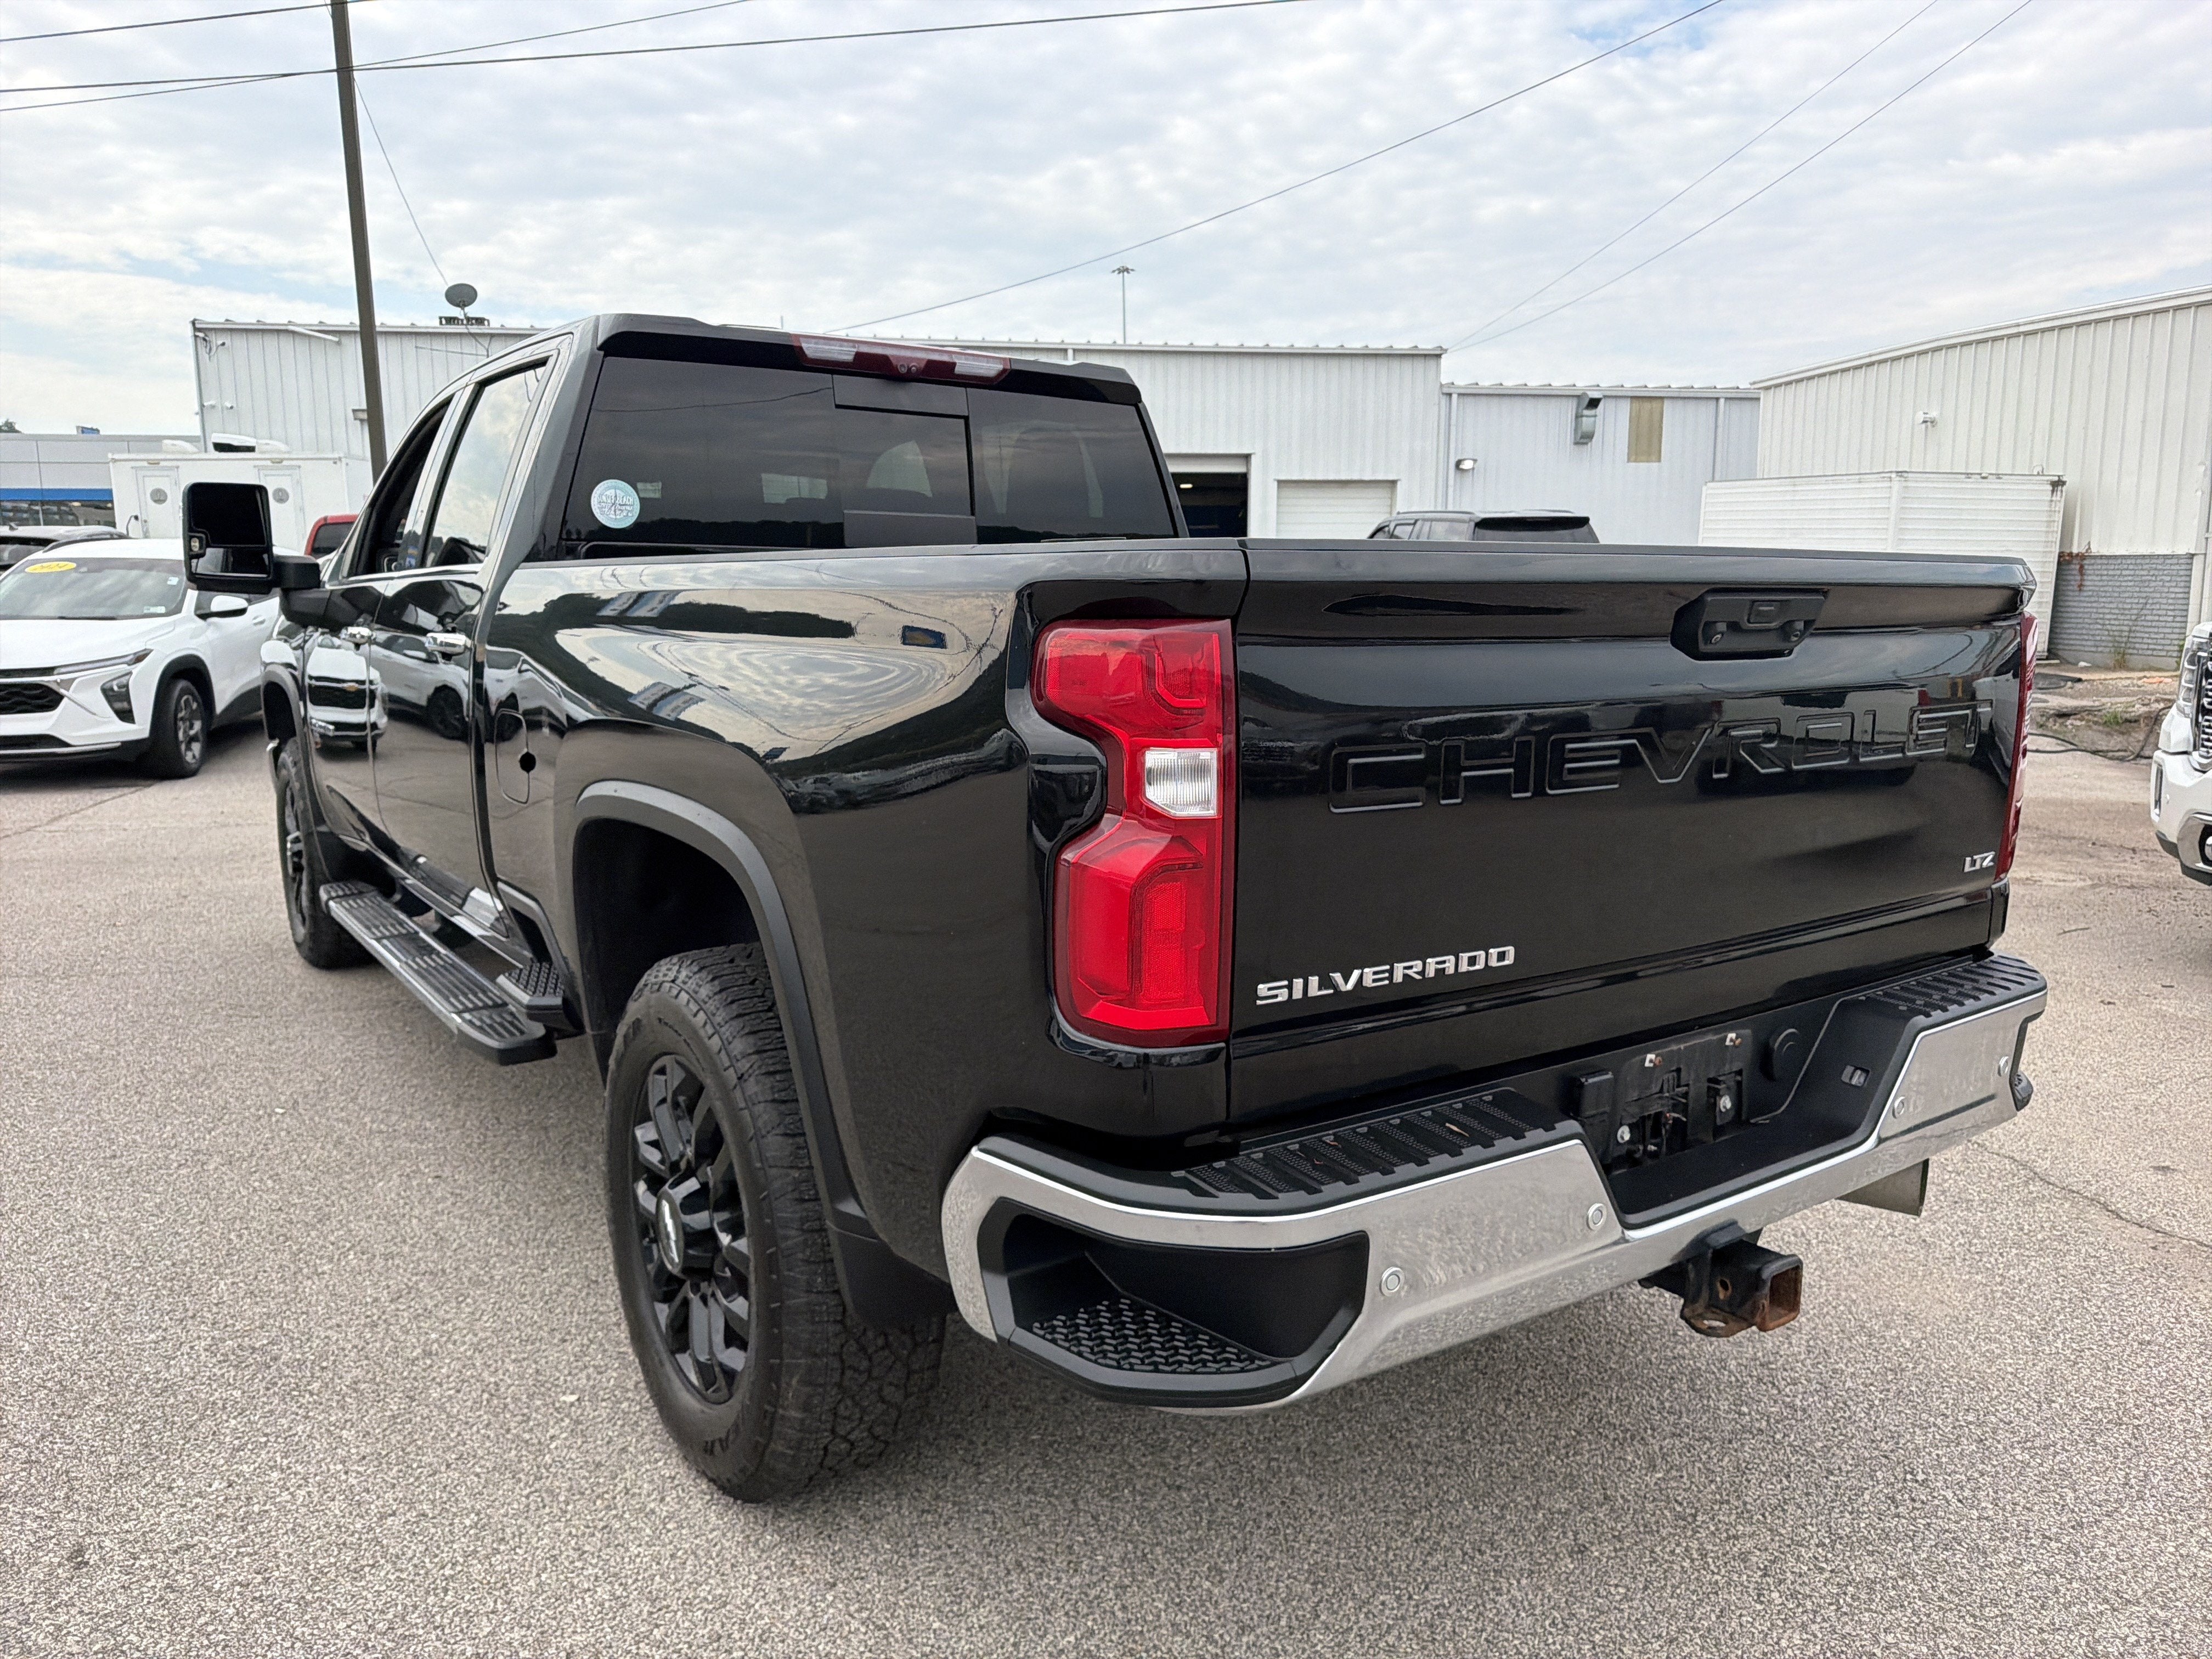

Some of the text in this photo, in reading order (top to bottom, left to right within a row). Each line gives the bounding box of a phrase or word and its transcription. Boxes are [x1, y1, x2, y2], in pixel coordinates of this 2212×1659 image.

[1329, 699, 1993, 813] CHEVROLET
[1963, 851, 1996, 873] LTZ
[1256, 946, 1515, 1005] SILVERADO
